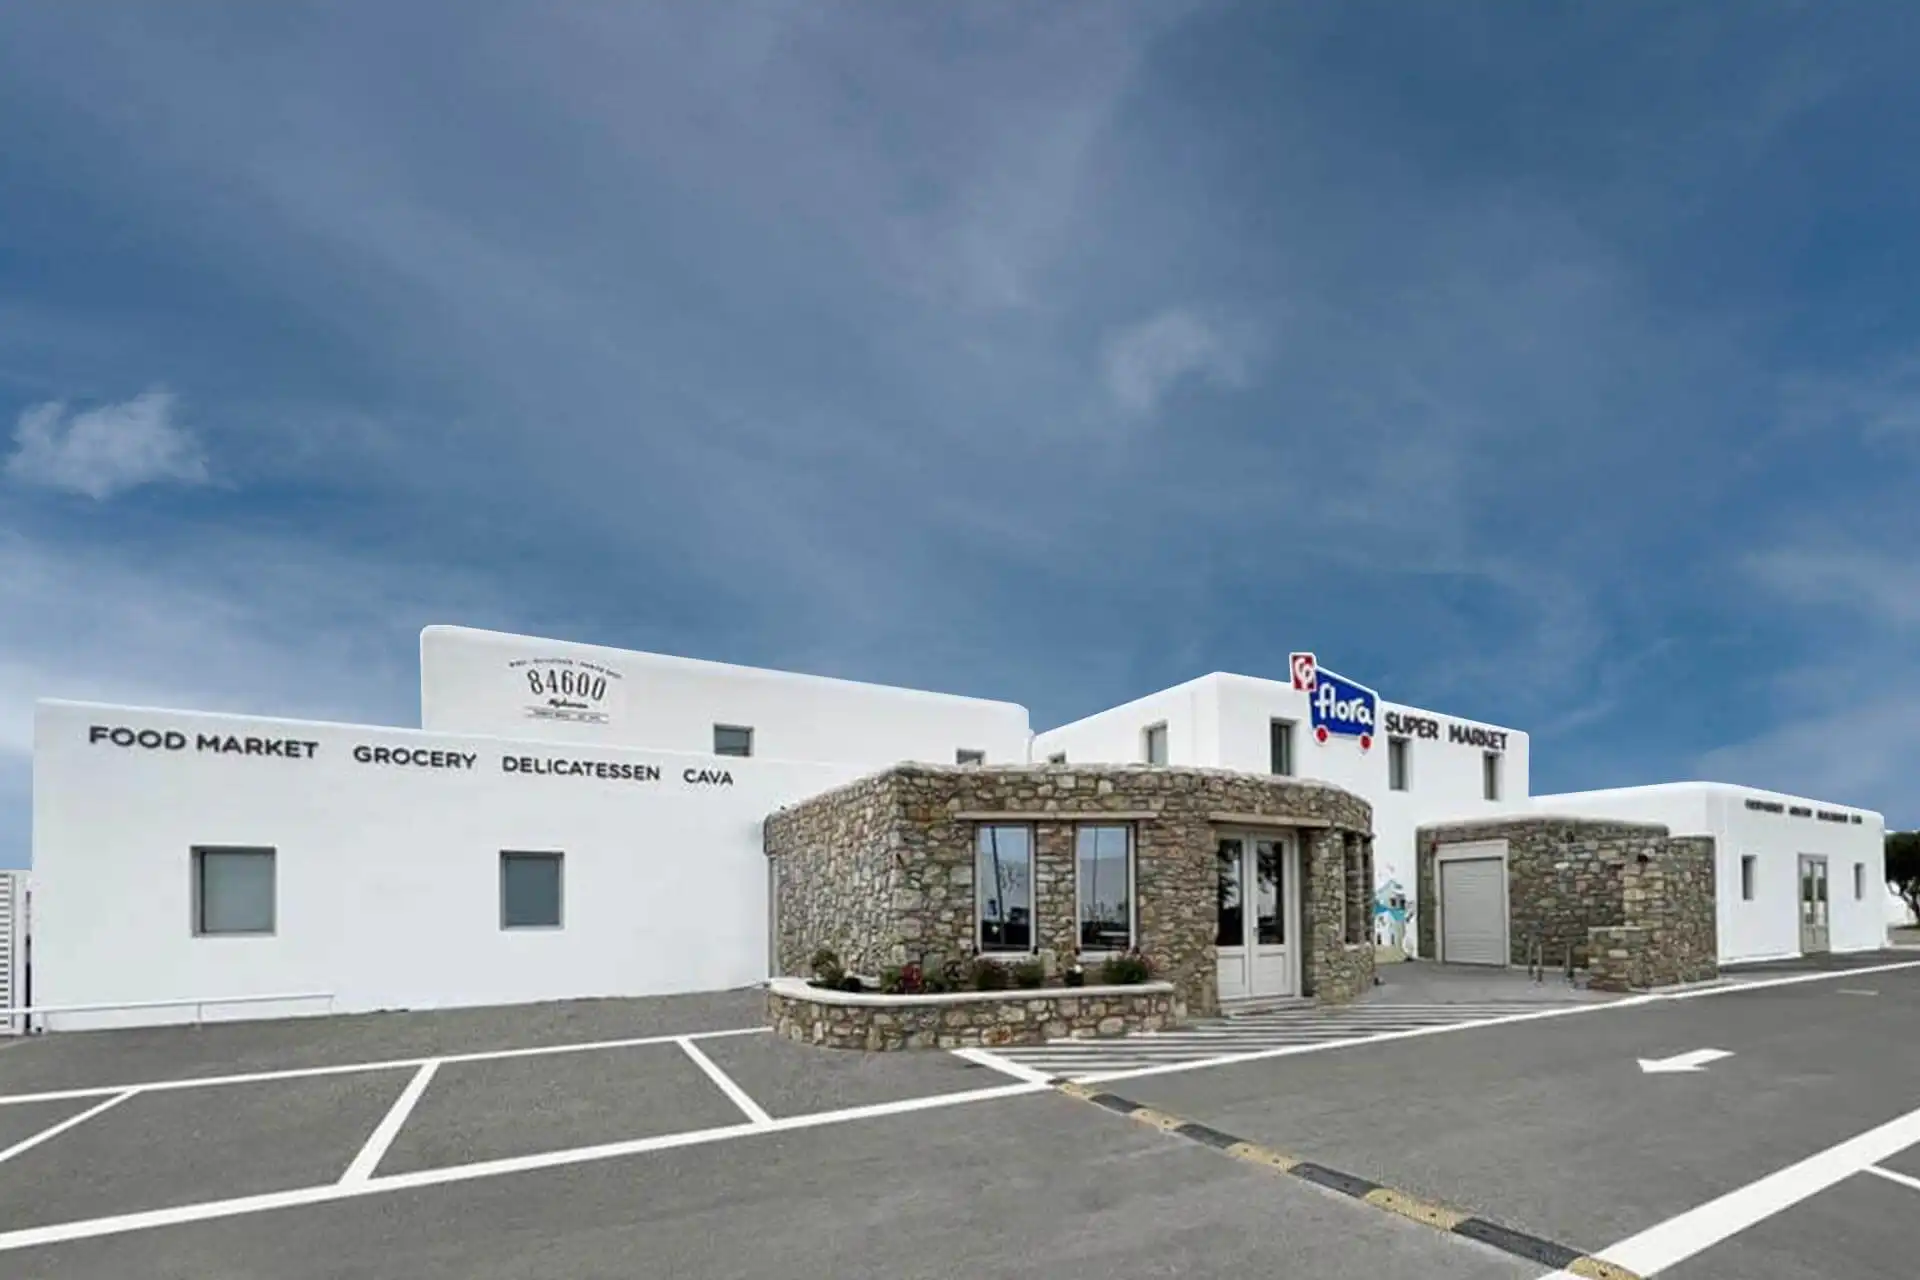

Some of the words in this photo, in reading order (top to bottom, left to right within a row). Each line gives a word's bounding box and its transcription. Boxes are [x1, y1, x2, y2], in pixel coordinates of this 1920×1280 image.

[527, 669, 607, 701] 84600
[1314, 682, 1373, 725] flora
[88, 725, 187, 750] FOOD
[196, 734, 320, 759] MARKET
[1384, 711, 1440, 740] SUPER
[1448, 724, 1508, 750] MARKET
[353, 745, 478, 769] GROCERY
[502, 755, 661, 781] DELICATESSEN
[683, 768, 734, 786] CAVA
